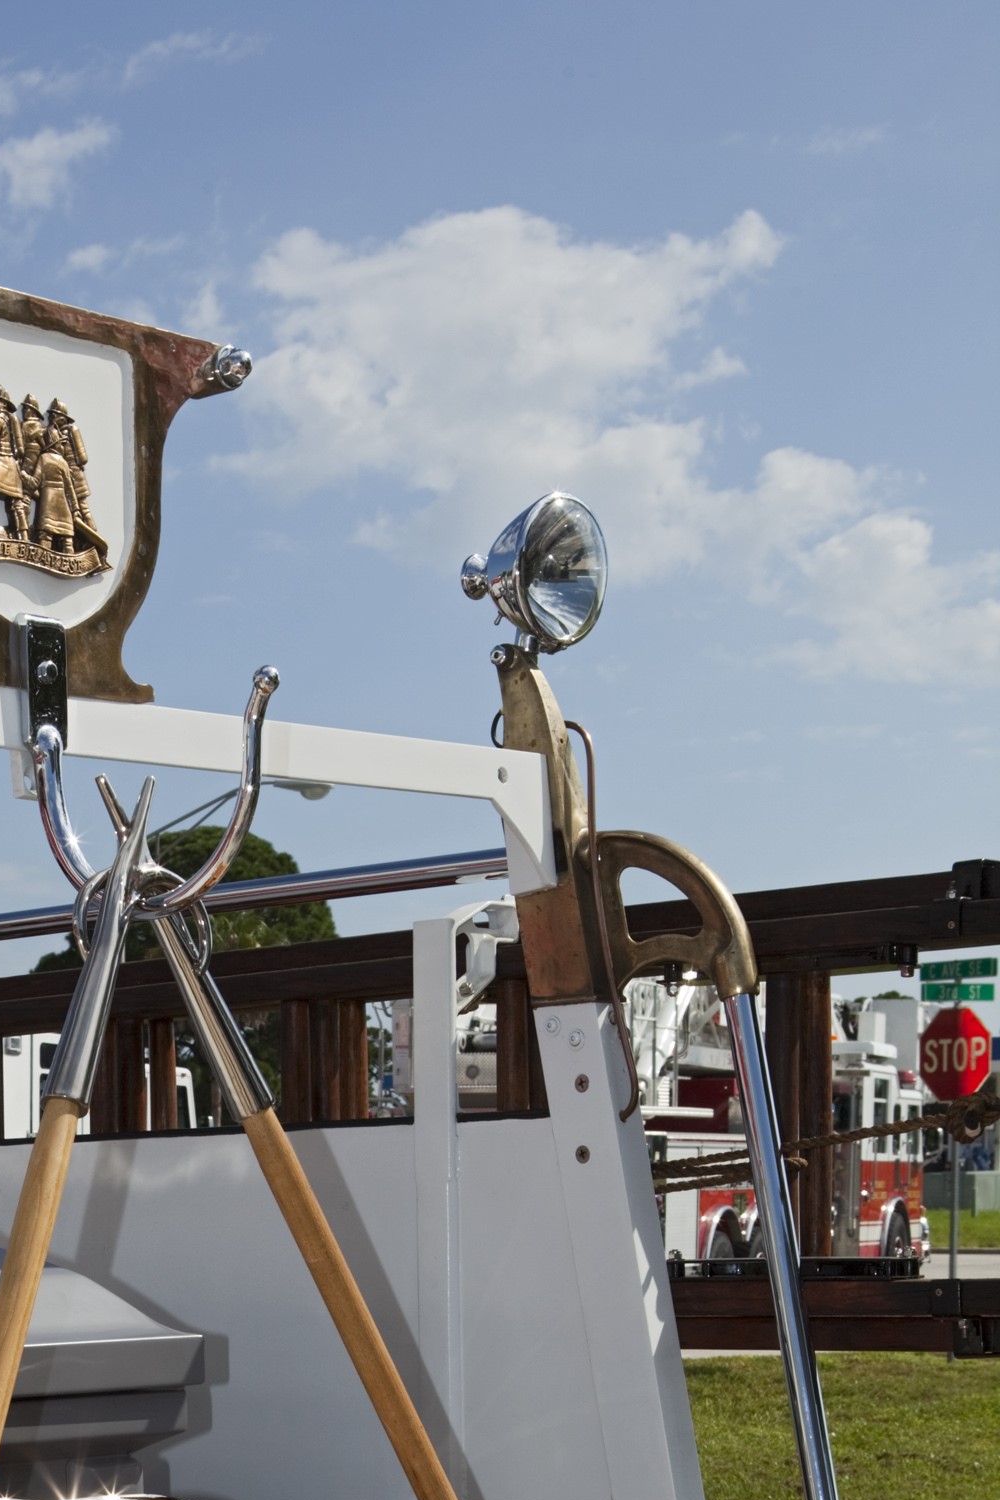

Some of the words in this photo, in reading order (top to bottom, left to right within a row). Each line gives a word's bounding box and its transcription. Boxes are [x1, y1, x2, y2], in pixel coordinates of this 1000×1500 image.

[17, 543, 83, 574] BRAVEST
[929, 964, 936, 978] C
[941, 961, 961, 977] AVE
[969, 959, 982, 976] SE
[938, 985, 959, 1000] 3rd
[969, 984, 982, 1000] ST
[923, 1036, 987, 1073] STOP
